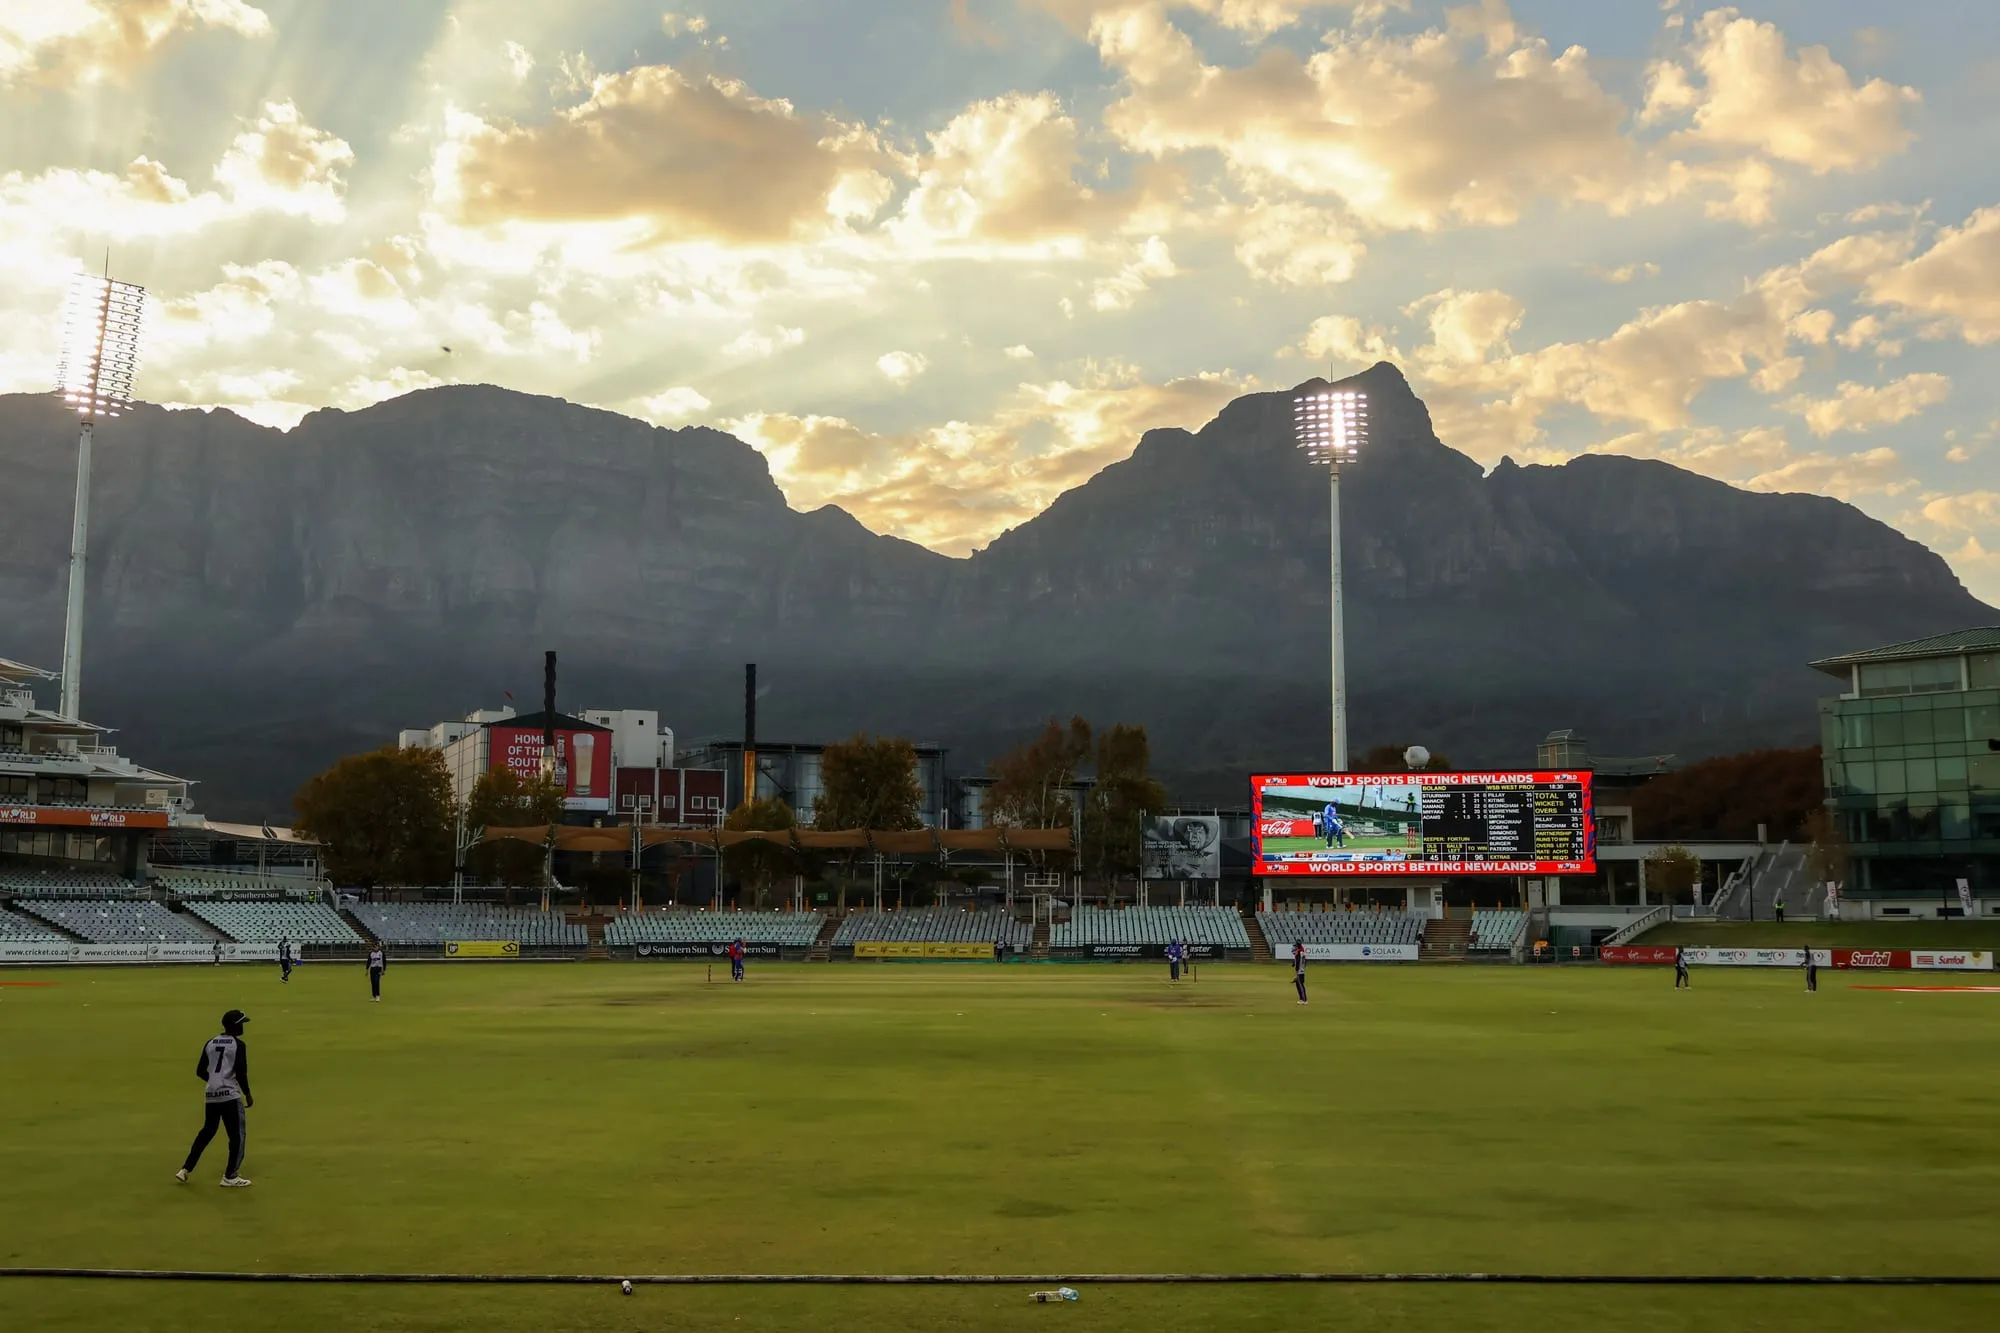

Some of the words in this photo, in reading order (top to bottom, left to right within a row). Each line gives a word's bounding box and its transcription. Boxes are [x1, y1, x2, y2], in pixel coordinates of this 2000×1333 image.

[508, 746, 522, 755] OF
[1307, 776, 1352, 786] WORLD
[1356, 776, 1405, 785] SPORTS
[1407, 775, 1462, 784] BETTING
[1467, 774, 1534, 783] NEWLANDS
[1309, 863, 1355, 872] WORLD
[1358, 863, 1406, 872] SPORTS
[1409, 862, 1461, 871] BETTING
[1465, 862, 1536, 871] NEWLANDS
[652, 946, 692, 954] Southern
[1851, 952, 1891, 966] Sunfoil
[1938, 956, 1965, 965] Sunfoil
[215, 1047, 225, 1073] 7
